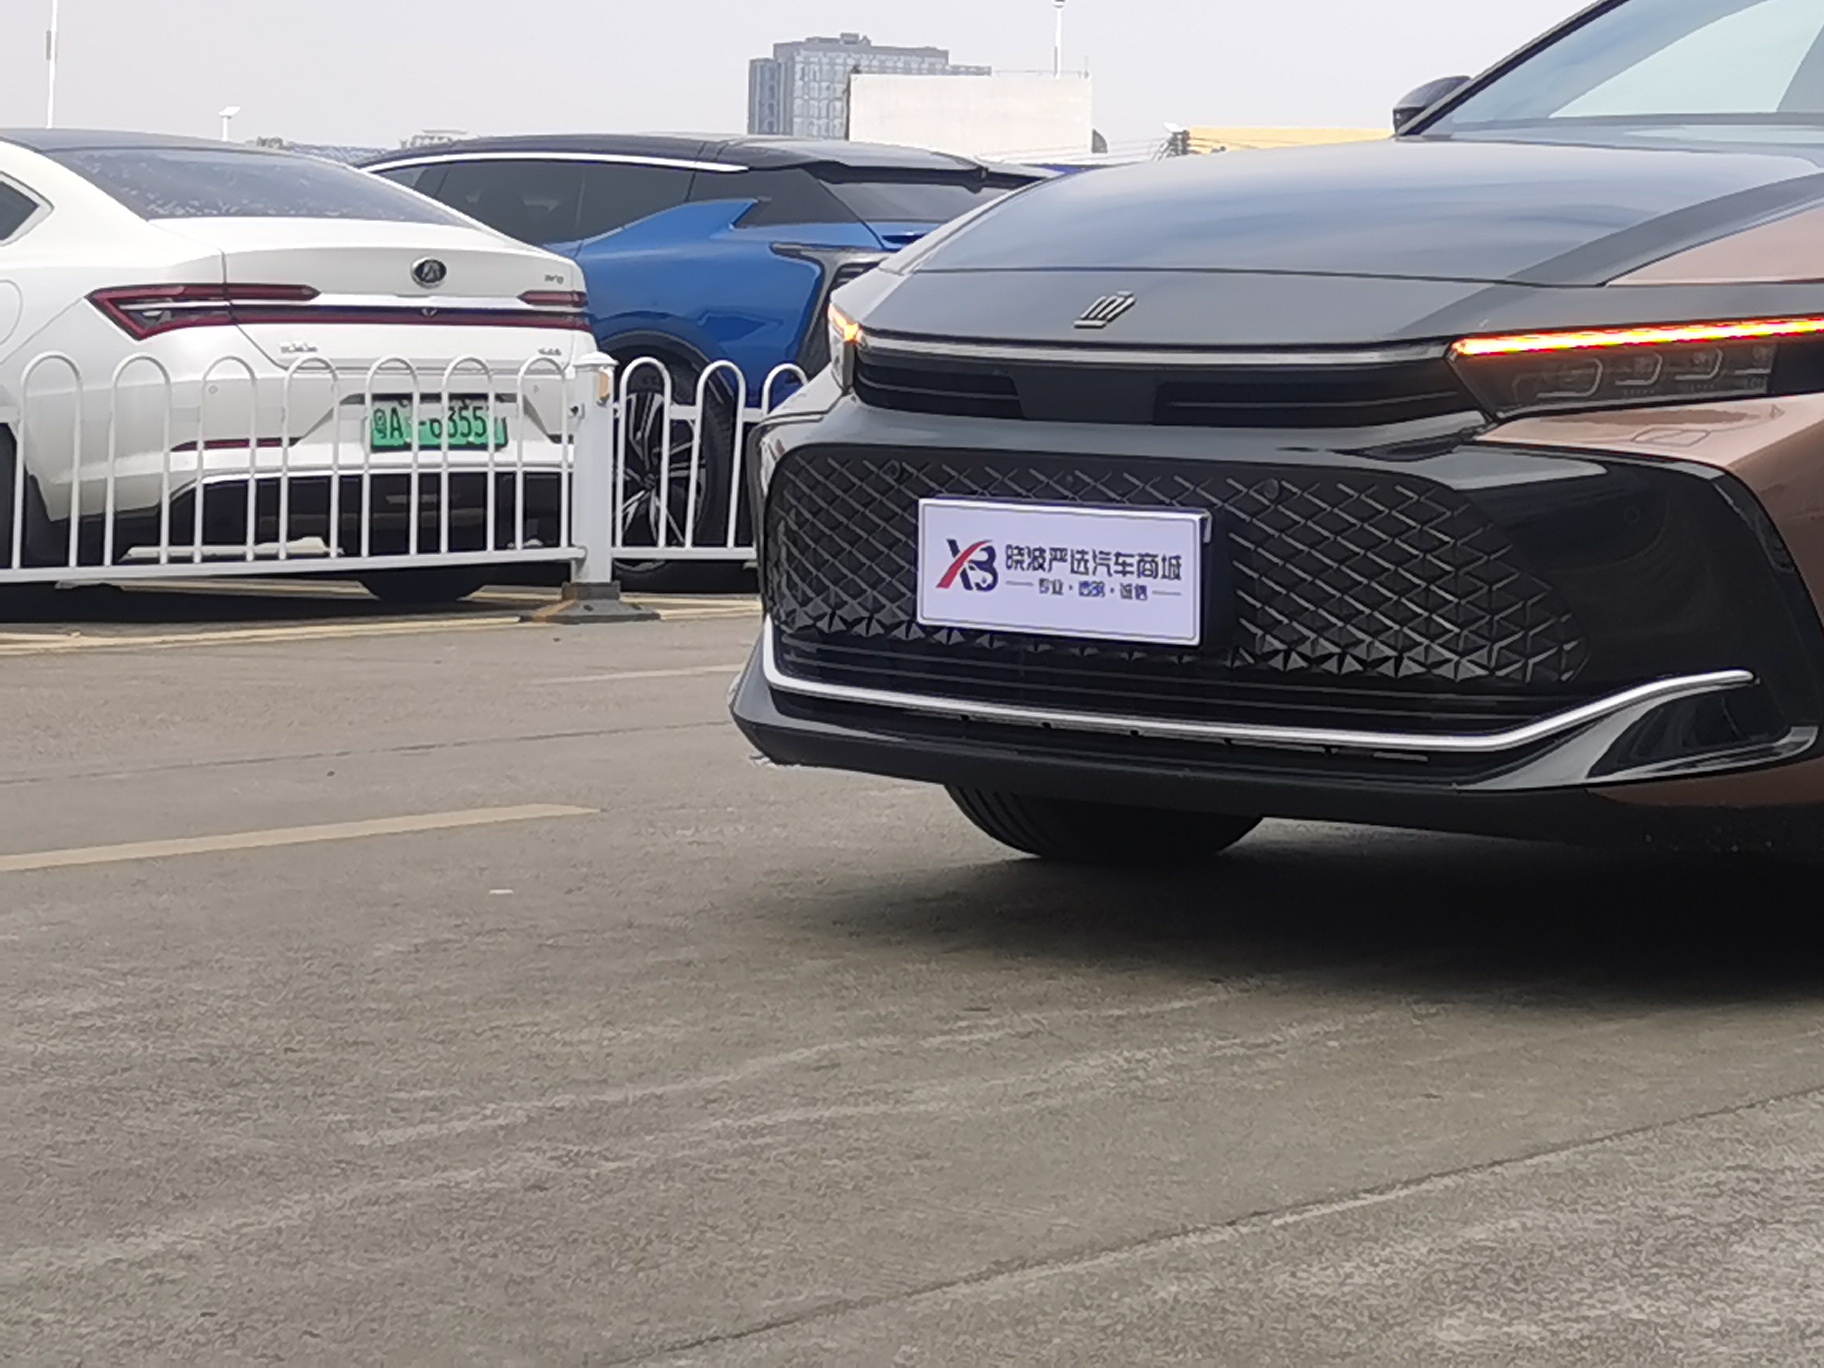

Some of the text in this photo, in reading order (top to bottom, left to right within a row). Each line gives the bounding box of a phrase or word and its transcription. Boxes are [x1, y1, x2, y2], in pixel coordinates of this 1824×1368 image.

[1005, 543, 1182, 581] 晓波严选汽车商城
